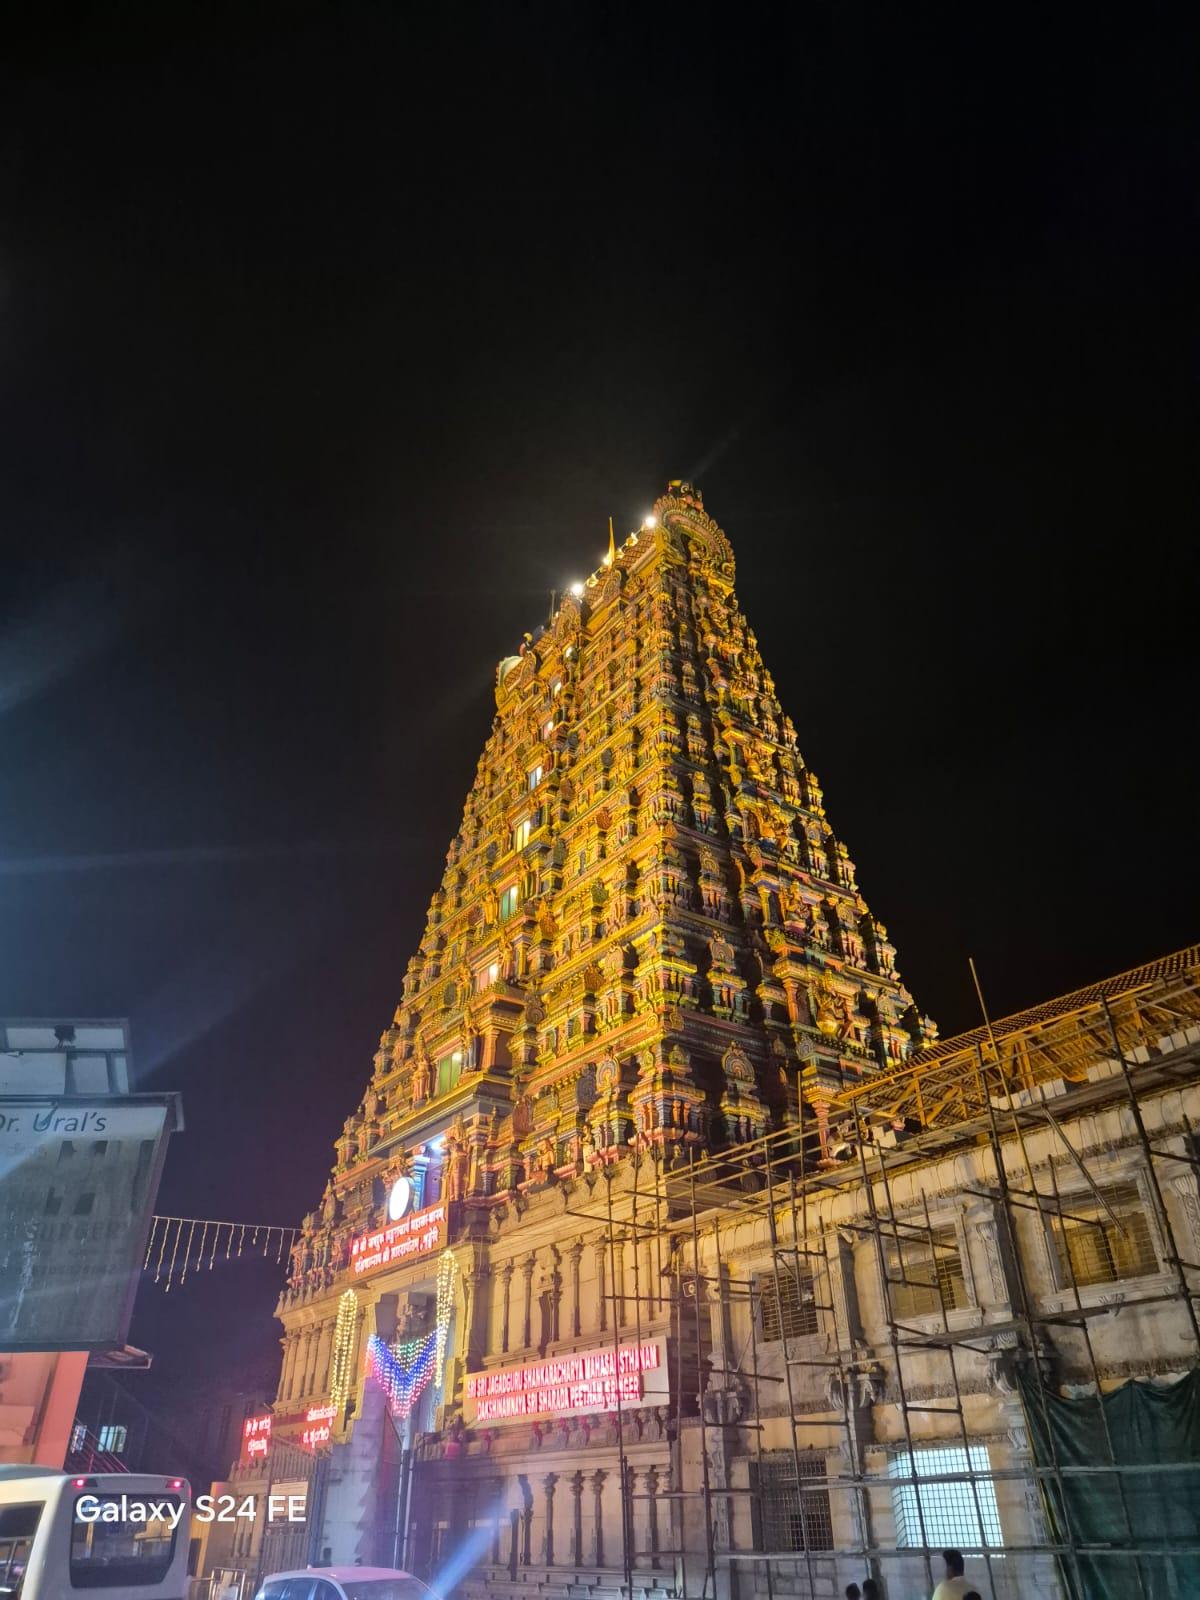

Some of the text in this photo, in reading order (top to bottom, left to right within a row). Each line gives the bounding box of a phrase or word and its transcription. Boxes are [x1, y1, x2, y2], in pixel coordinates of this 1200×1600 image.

[32, 1111, 107, 1133] Ural's
[467, 1378, 477, 1399] SRI
[477, 1376, 487, 1397] SRI
[487, 1371, 523, 1396] JAGADGURU
[523, 1358, 584, 1391] SHANKARACHARYA
[526, 1392, 537, 1413] SRI
[538, 1386, 569, 1412] SHARADA
